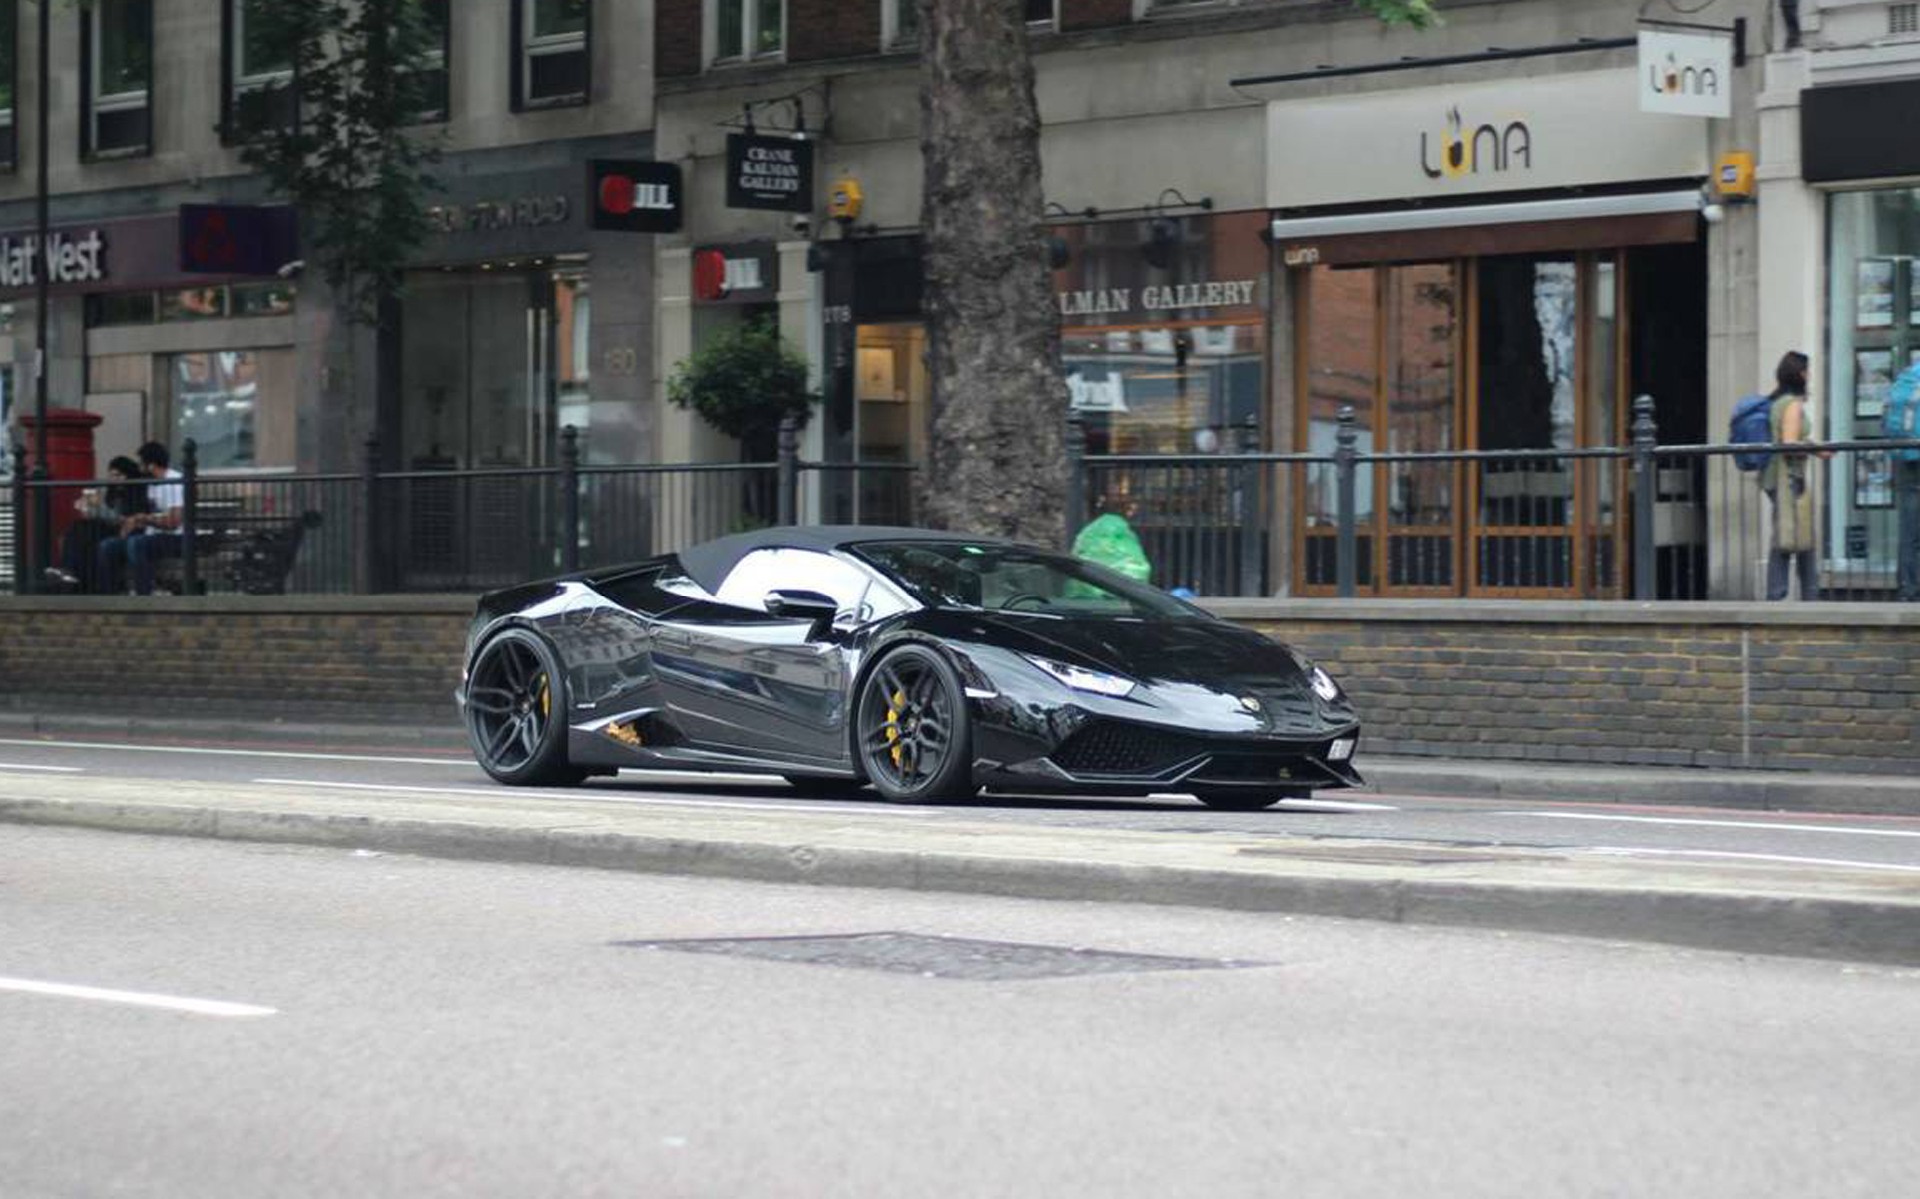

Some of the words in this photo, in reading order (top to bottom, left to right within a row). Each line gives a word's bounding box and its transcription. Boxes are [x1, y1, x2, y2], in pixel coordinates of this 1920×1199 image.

[748, 148, 793, 163] CRANE
[1421, 121, 1531, 178] LUNA
[742, 161, 799, 176] KALMAN
[740, 176, 799, 191] GALLERY
[1142, 280, 1255, 309] GALLERY
